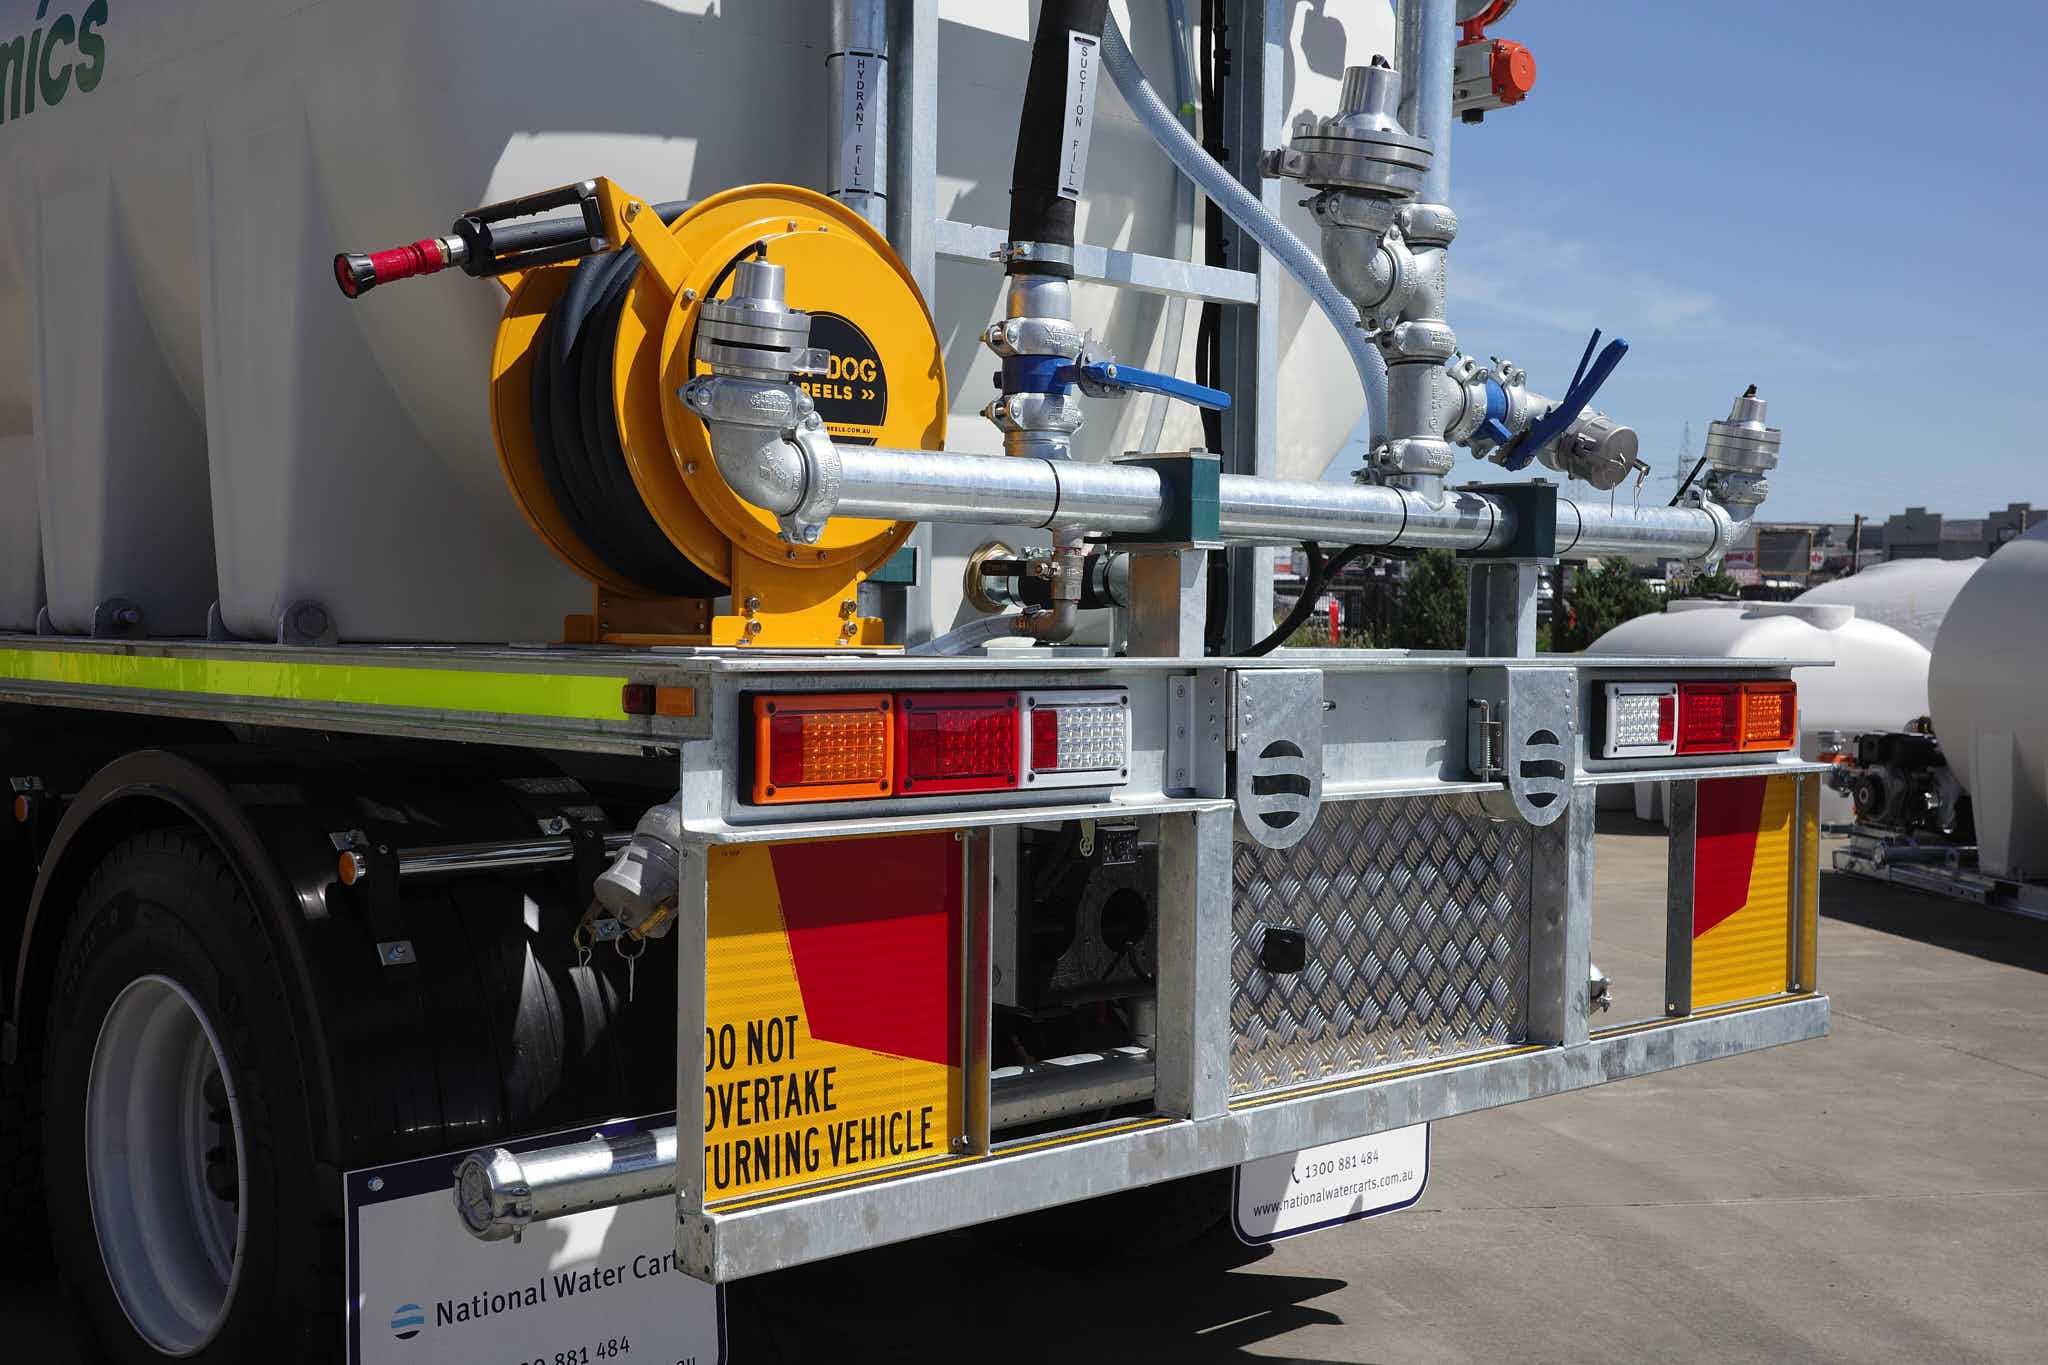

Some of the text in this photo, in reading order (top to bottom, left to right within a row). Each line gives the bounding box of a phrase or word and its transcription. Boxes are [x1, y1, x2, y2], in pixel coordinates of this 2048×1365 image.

[854, 59, 865, 186] HYDRANT FILL
[1068, 46, 1088, 186] SUCTION FILL
[800, 382, 853, 400] REELS
[747, 1015, 798, 1066] NOT
[704, 1066, 837, 1133] OVERTAKE
[828, 1106, 934, 1167] VEHICLE
[1305, 1150, 1379, 1179] 1300 881 484
[1253, 1168, 1413, 1217] www.nationalwatercarts.com.au
[436, 1277, 547, 1327] National
[554, 1264, 626, 1298] Water
[596, 1335, 630, 1360] 484
